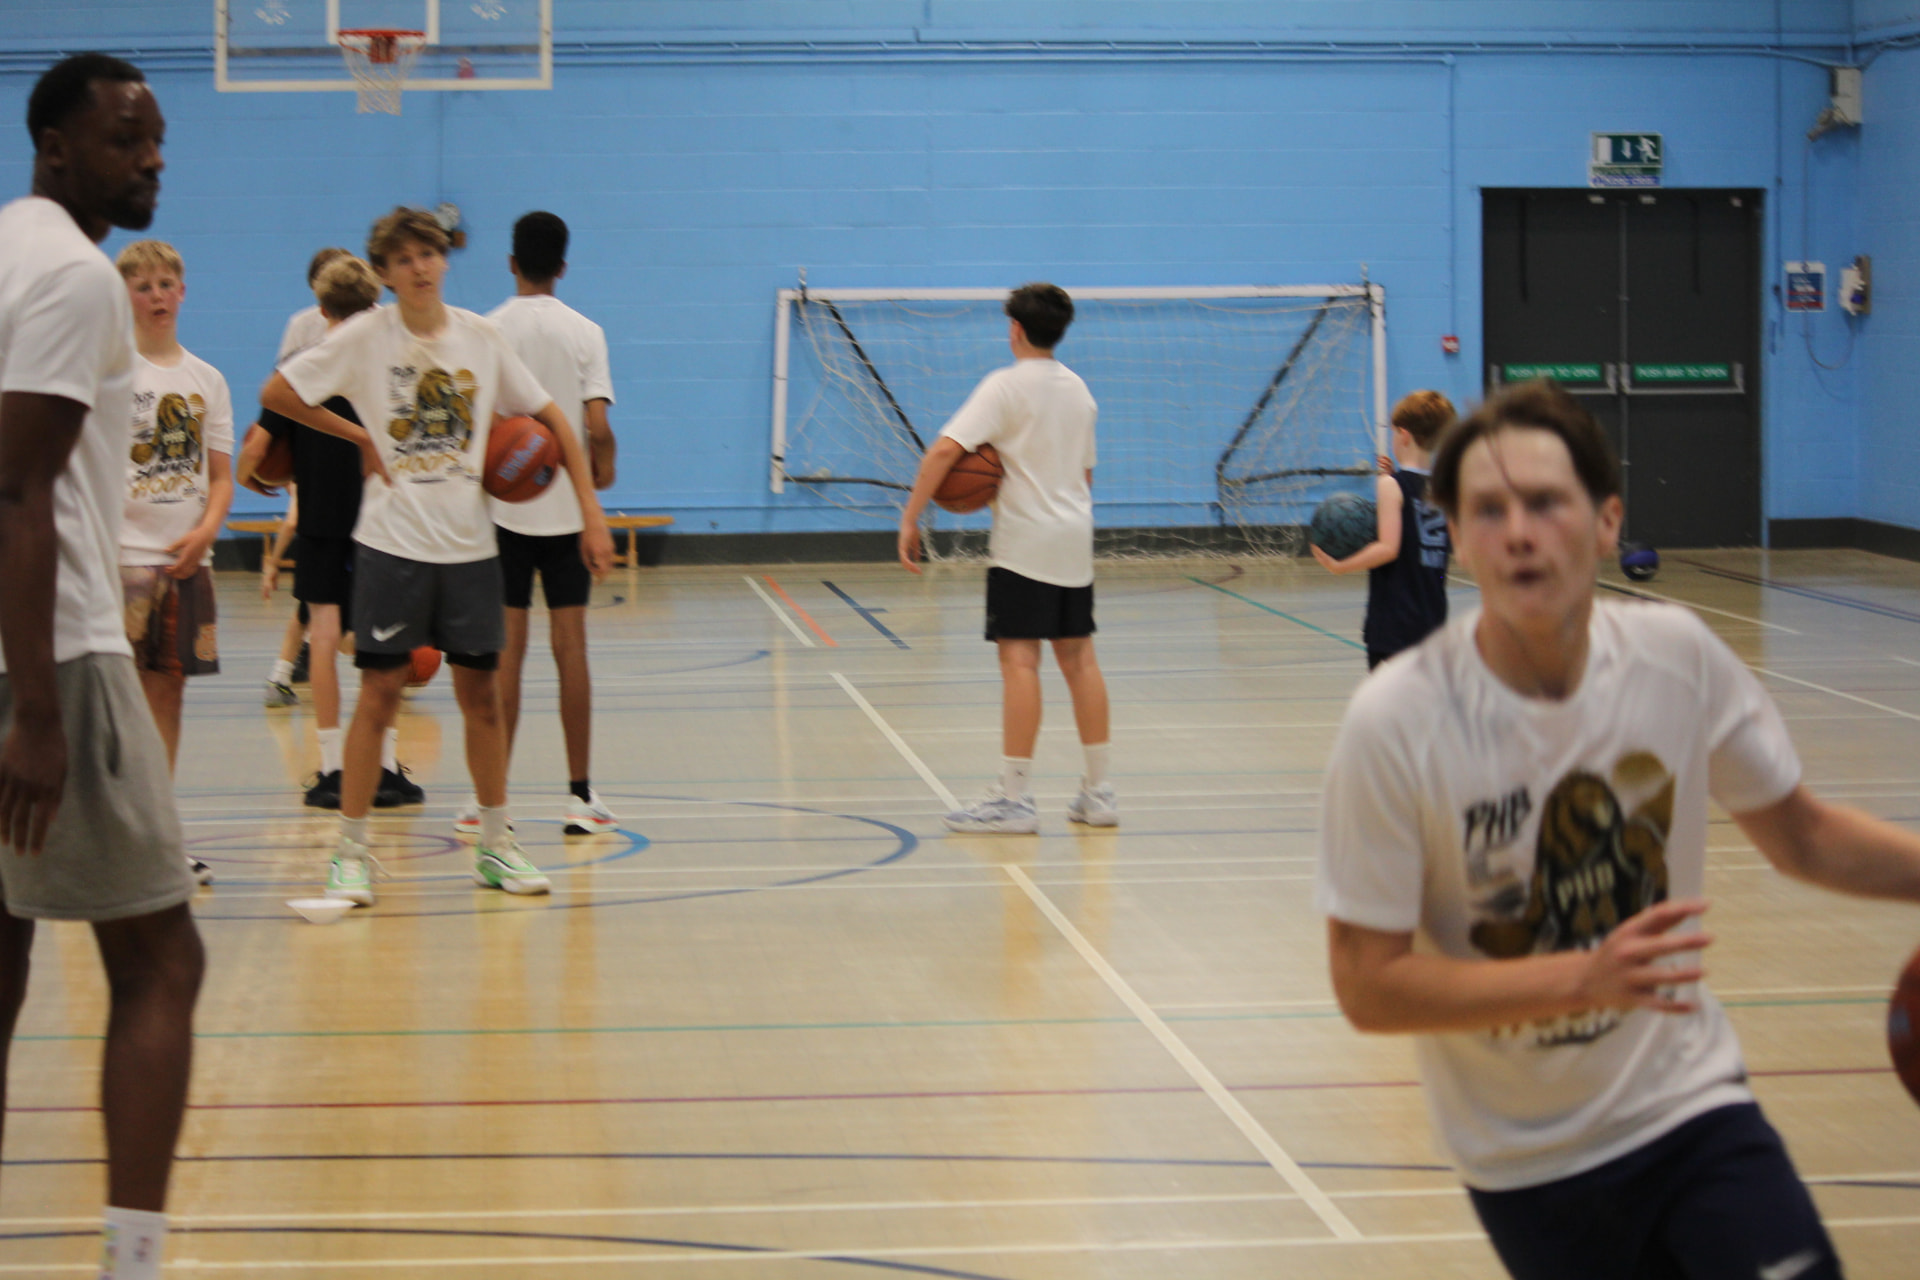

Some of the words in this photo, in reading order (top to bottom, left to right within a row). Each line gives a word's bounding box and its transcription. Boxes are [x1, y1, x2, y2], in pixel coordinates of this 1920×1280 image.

[1508, 367, 1534, 378] PUSH
[1573, 367, 1599, 378] OPEN
[1638, 367, 1663, 378] PUSH
[1665, 367, 1684, 378] BAR
[1702, 367, 1728, 378] OPEN
